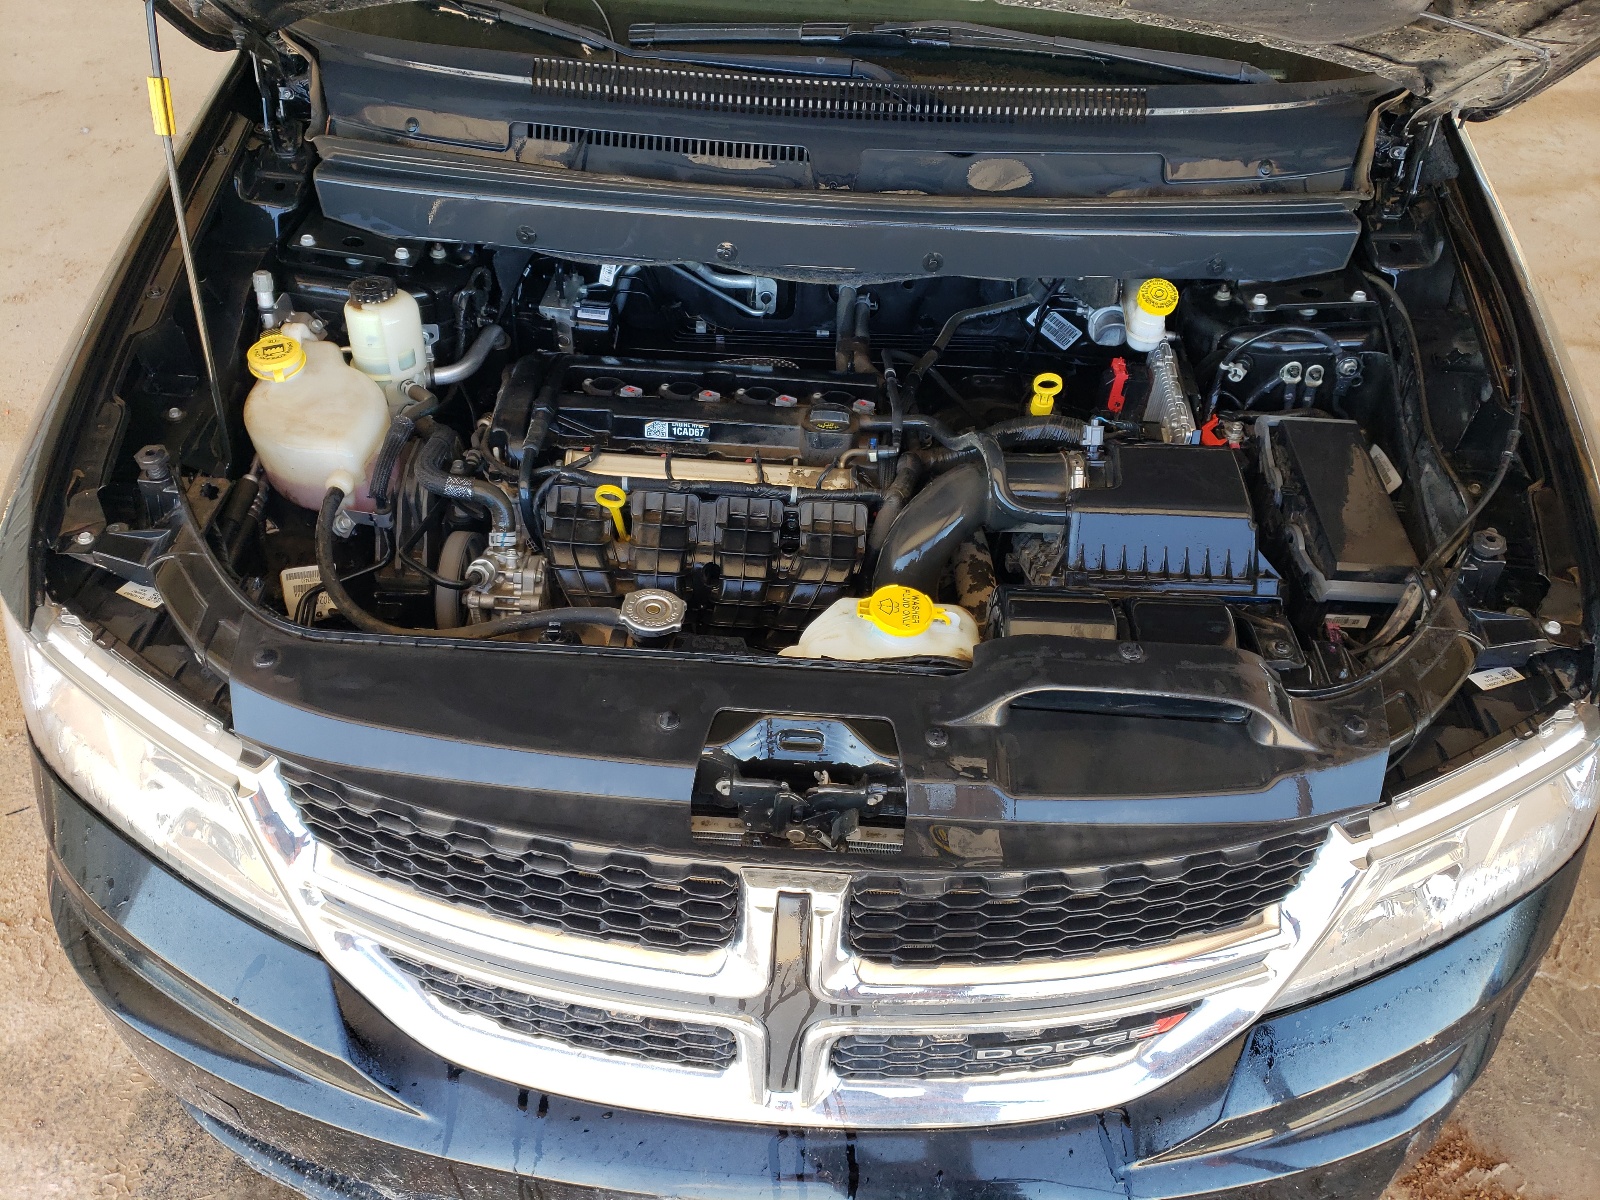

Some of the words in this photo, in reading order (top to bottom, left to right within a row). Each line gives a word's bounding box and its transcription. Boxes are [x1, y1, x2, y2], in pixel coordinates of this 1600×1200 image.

[672, 427, 705, 437] 1CAD67
[902, 589, 911, 609] FLUID
[911, 594, 920, 624] WASHER
[902, 610, 911, 628] ONLY
[976, 1023, 1161, 1060] DODGE
